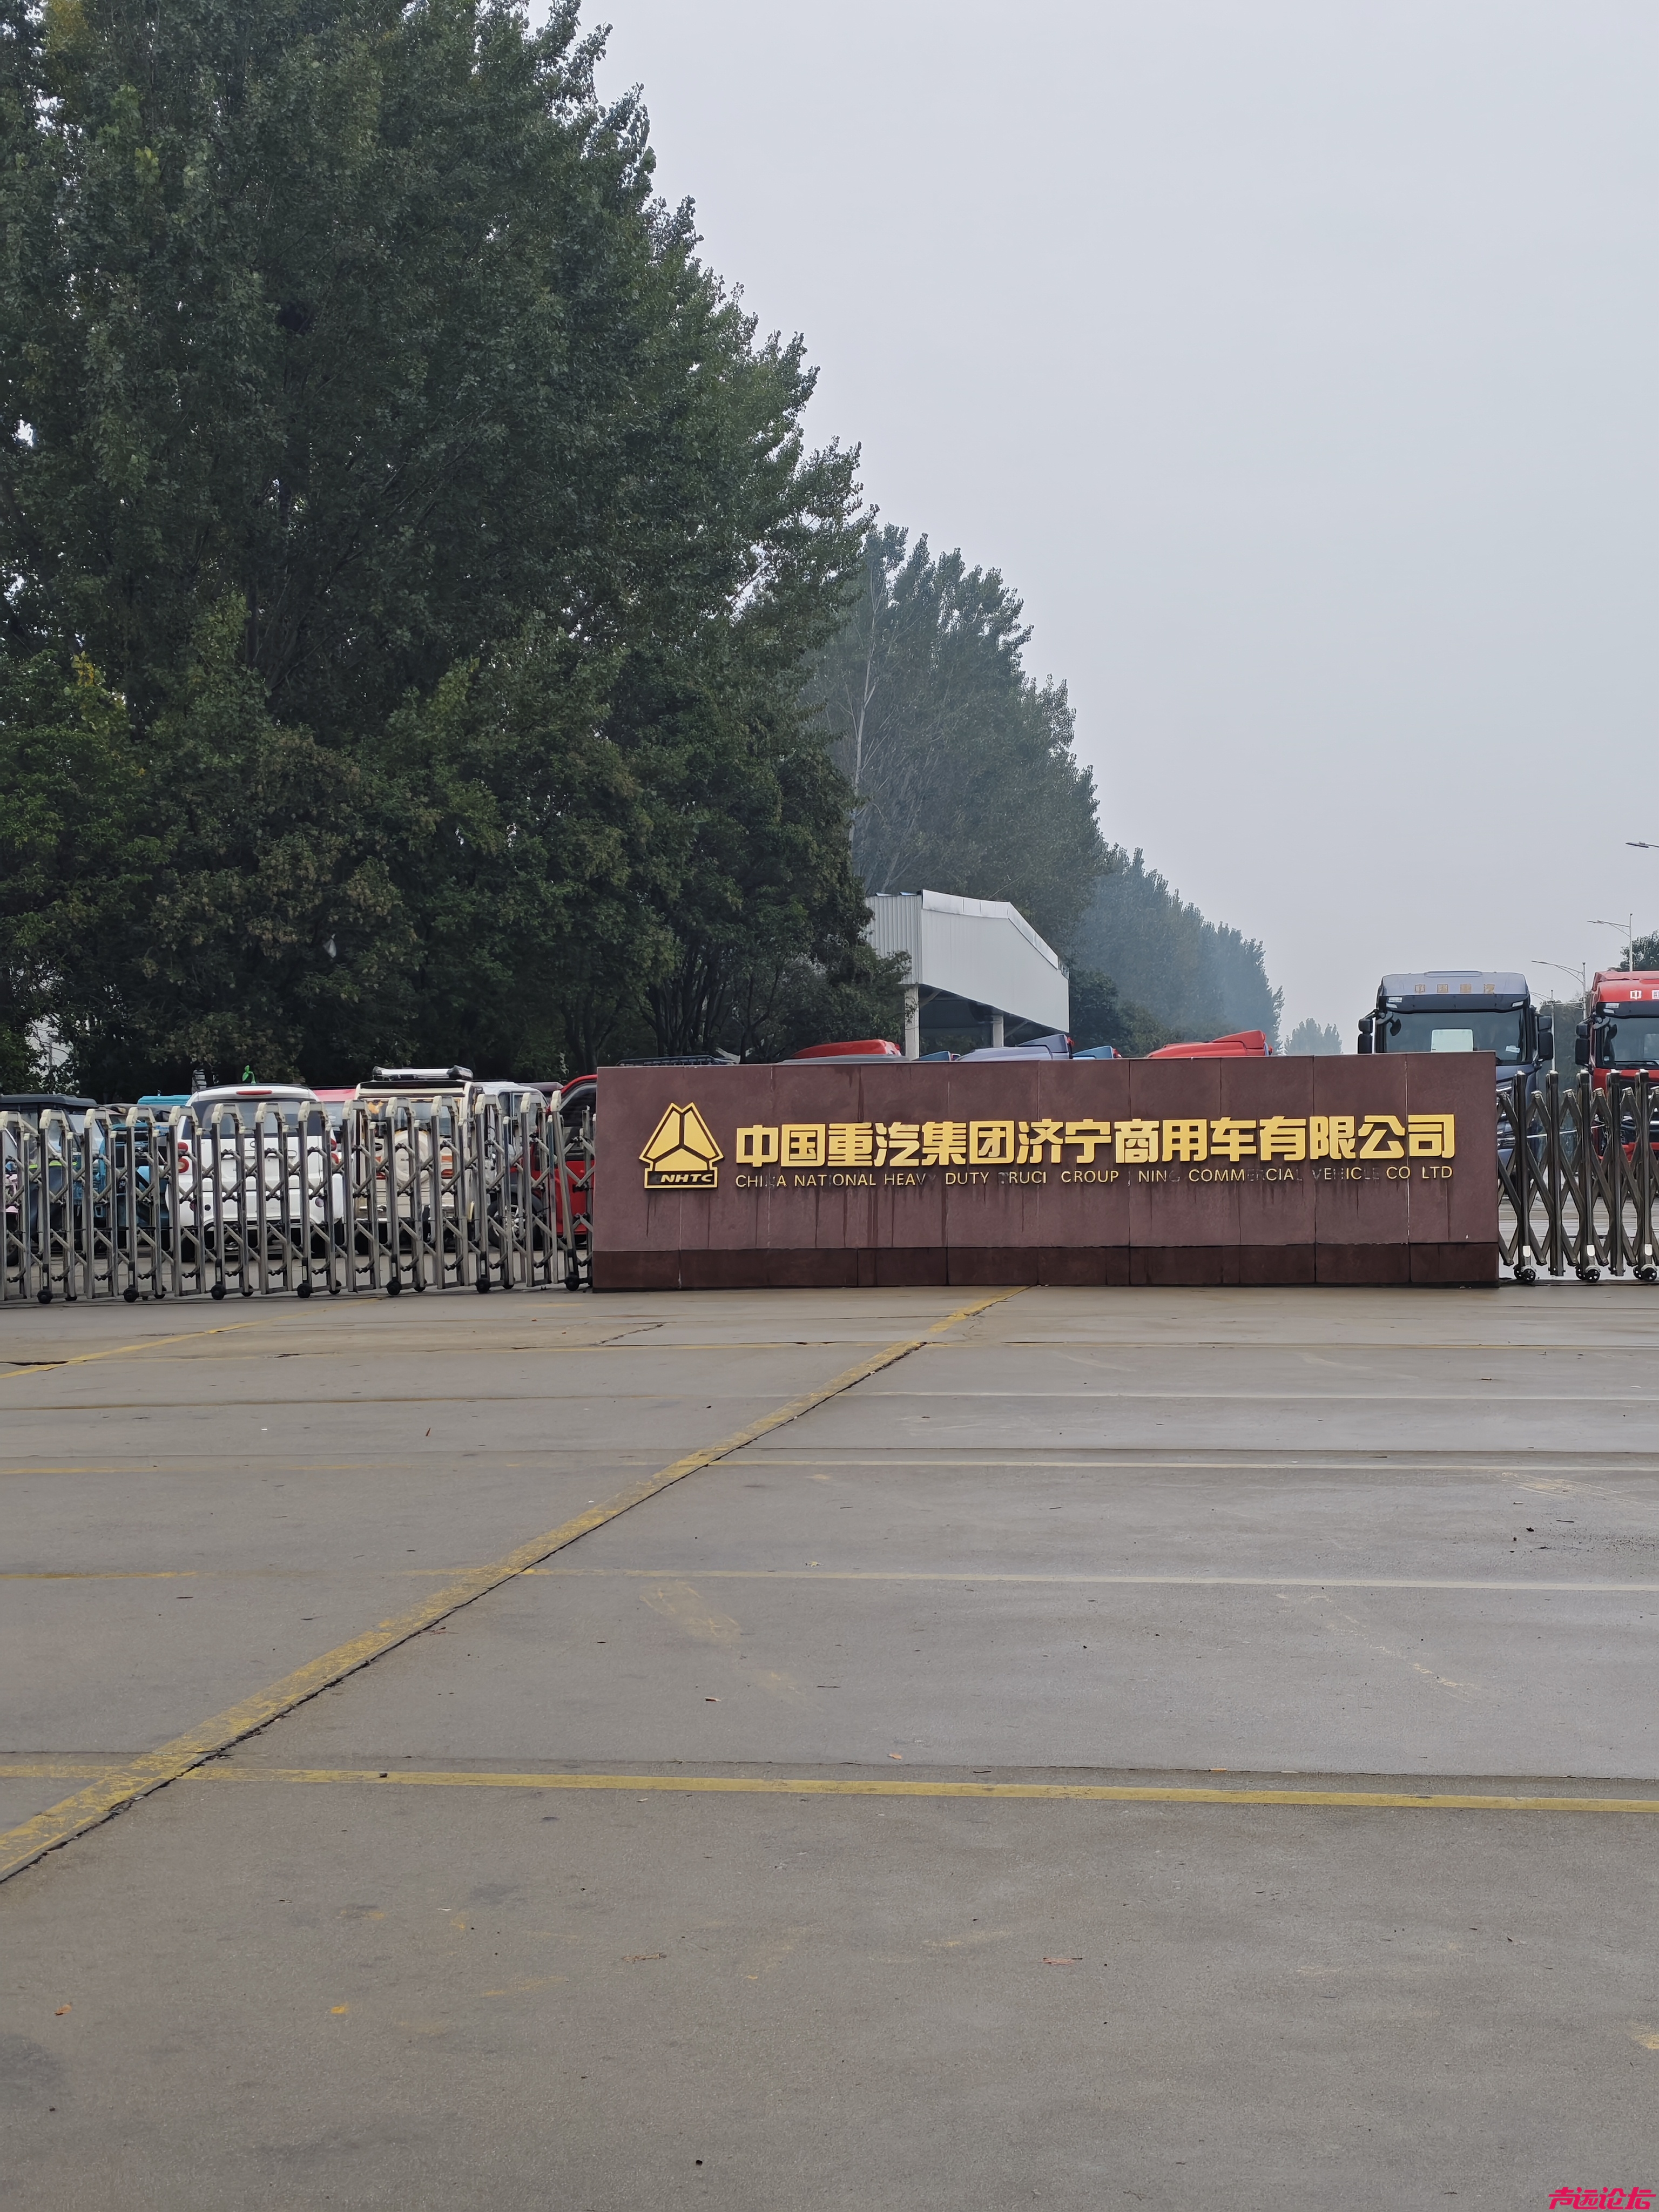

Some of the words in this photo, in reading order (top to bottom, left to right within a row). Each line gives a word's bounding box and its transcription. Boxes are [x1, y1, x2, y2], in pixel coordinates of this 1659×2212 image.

[736, 1114, 1455, 1168] 中国重汽集团济宁商用车有限公司
[945, 1171, 989, 1185] DUTY
[1386, 1165, 1411, 1179] CO
[1421, 1165, 1453, 1179] LTD
